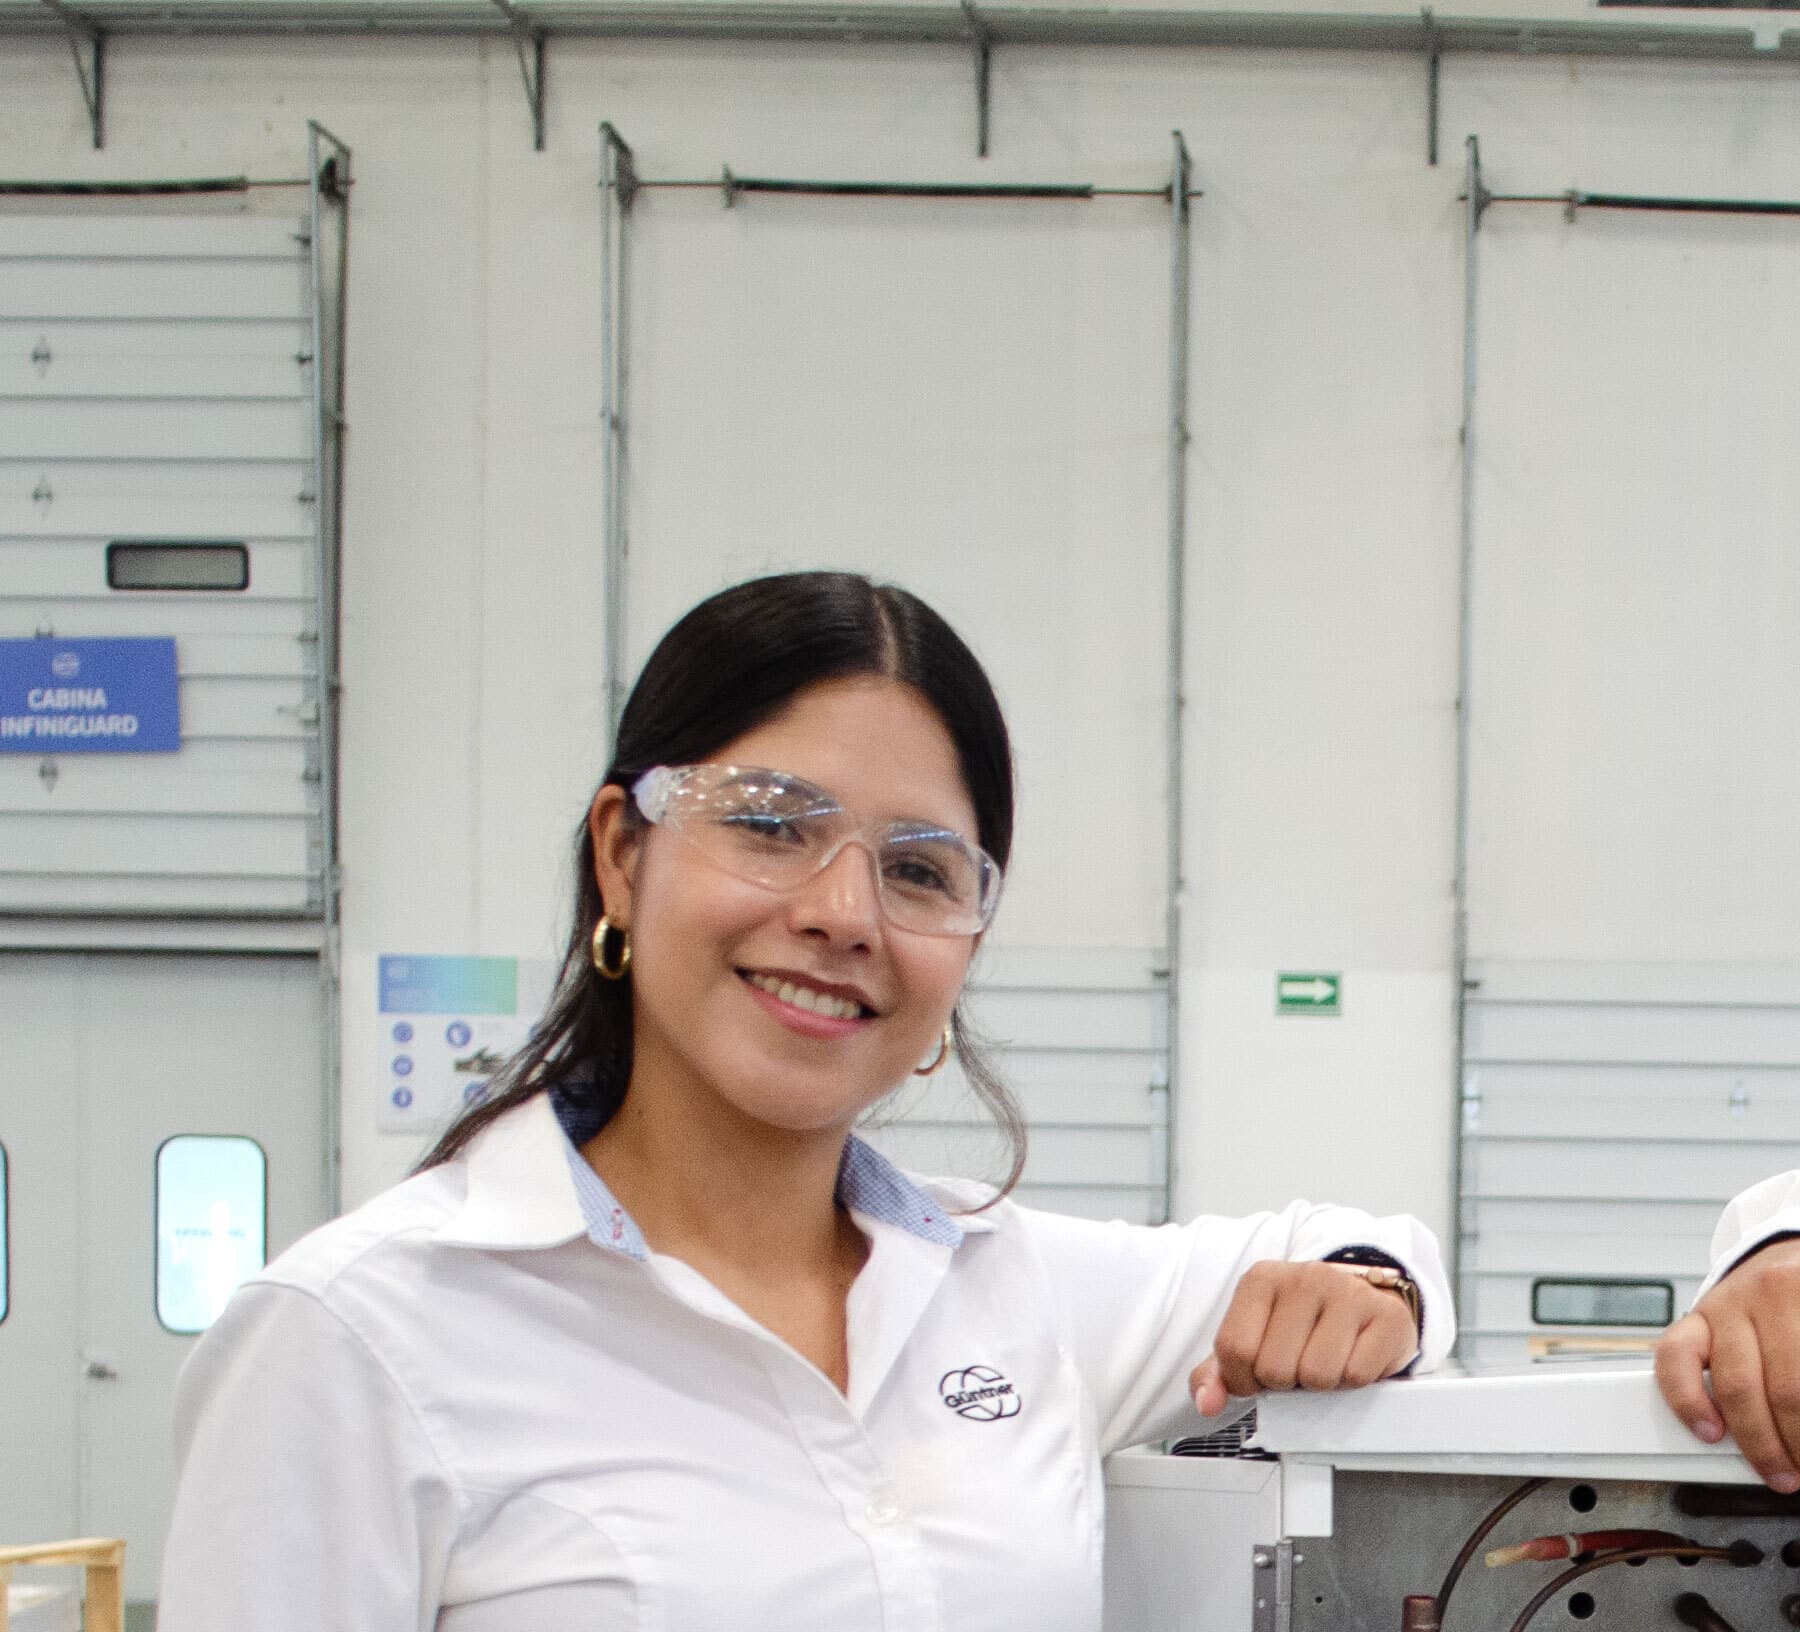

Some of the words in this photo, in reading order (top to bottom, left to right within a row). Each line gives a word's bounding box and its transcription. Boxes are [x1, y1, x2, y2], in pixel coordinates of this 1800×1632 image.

[28, 687, 108, 710] CABINA
[0, 714, 139, 737] INFINIGUARD
[945, 1383, 1014, 1408] Güntner
